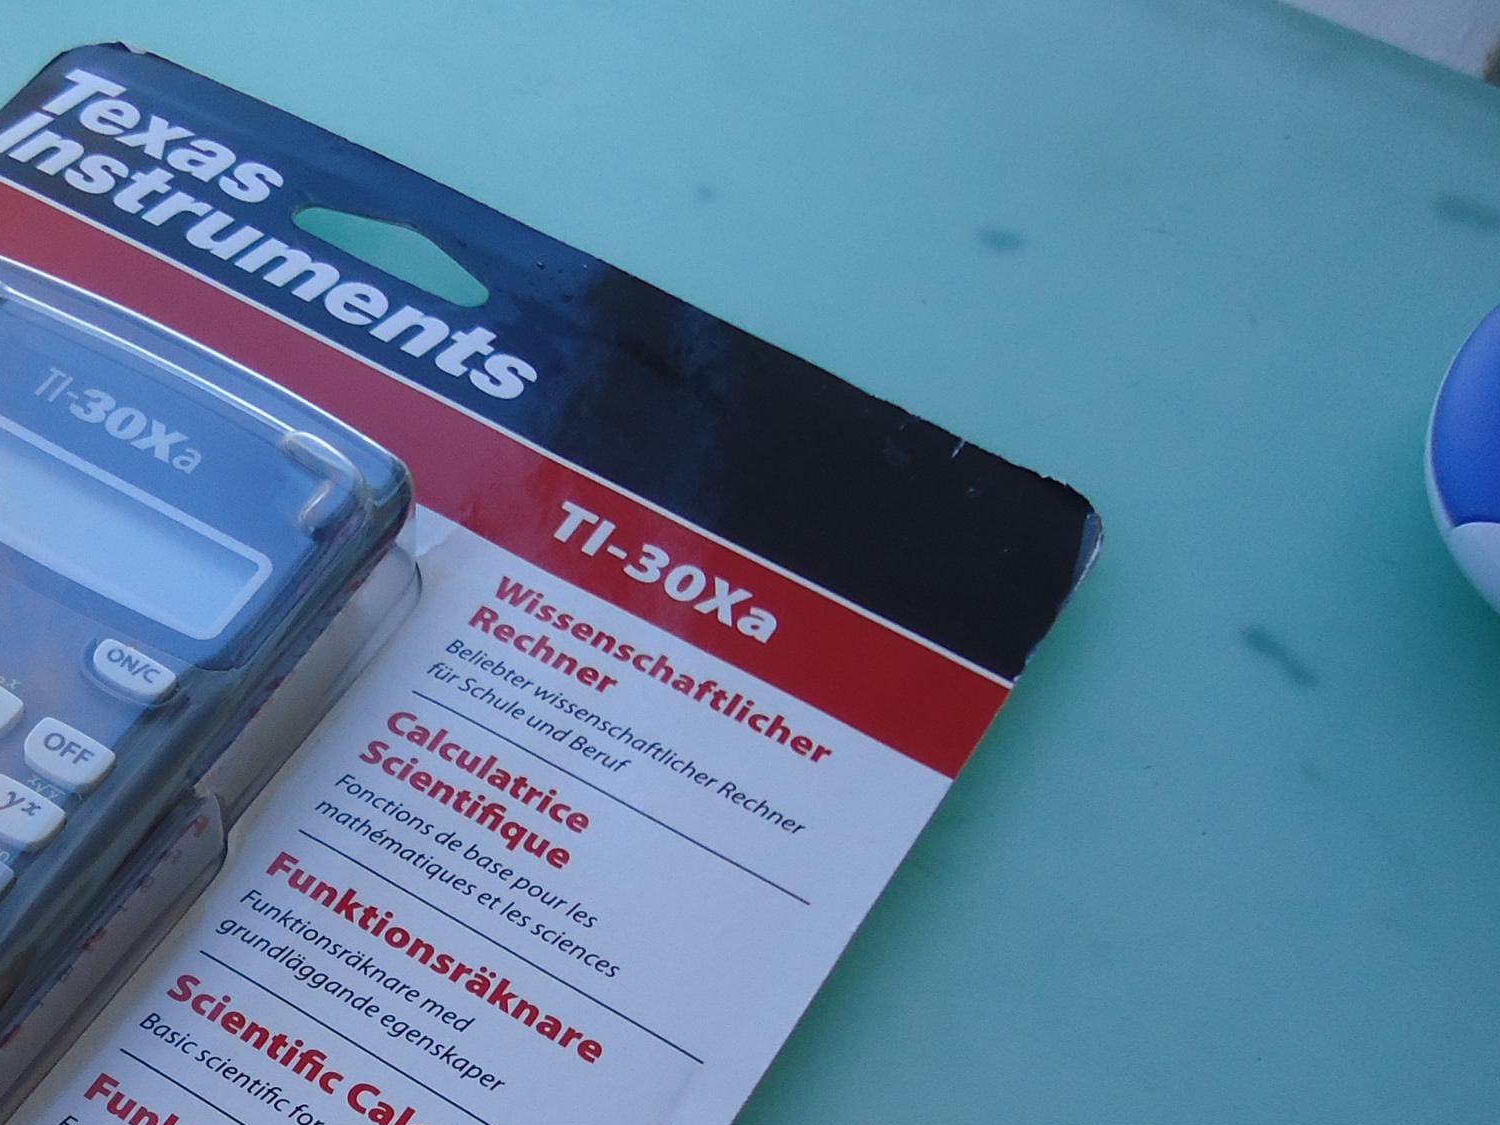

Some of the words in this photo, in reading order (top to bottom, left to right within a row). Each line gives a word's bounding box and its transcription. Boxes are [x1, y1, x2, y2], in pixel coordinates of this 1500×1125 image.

[40, 68, 285, 204] Texas
[34, 367, 204, 475] TI-30Xa
[552, 500, 779, 643] TI-30Xa
[107, 649, 161, 684] ON/C
[468, 605, 618, 693] Rechner
[495, 575, 832, 763] Wissenschaftlicher
[44, 733, 95, 765] OFF
[387, 711, 590, 834] Calculatrice
[426, 661, 458, 687] für
[458, 677, 526, 720] Schule
[527, 712, 571, 744] und
[568, 736, 633, 773] Beruf
[446, 639, 534, 694] Beliebter
[533, 684, 718, 787] wissenschaftlicher
[716, 781, 806, 834] Rechner
[335, 774, 435, 837] Fonctions
[435, 828, 463, 852] de
[463, 844, 514, 881] base
[509, 874, 567, 911] pour
[567, 901, 598, 929] les
[359, 740, 571, 870] Scientifique
[315, 799, 477, 897] mathématiques
[477, 888, 501, 912] et
[500, 902, 531, 929] les
[531, 922, 621, 979] sciences
[215, 917, 380, 1018] grundläggande
[379, 1015, 506, 1094] egenskaper
[240, 890, 421, 1003] Funktionsräknare
[420, 995, 476, 1033] med
[266, 852, 603, 1063] Funktionsräknare
[140, 1013, 198, 1054] Basic
[196, 1050, 292, 1113] scientific
[167, 975, 346, 1094] Scientific
